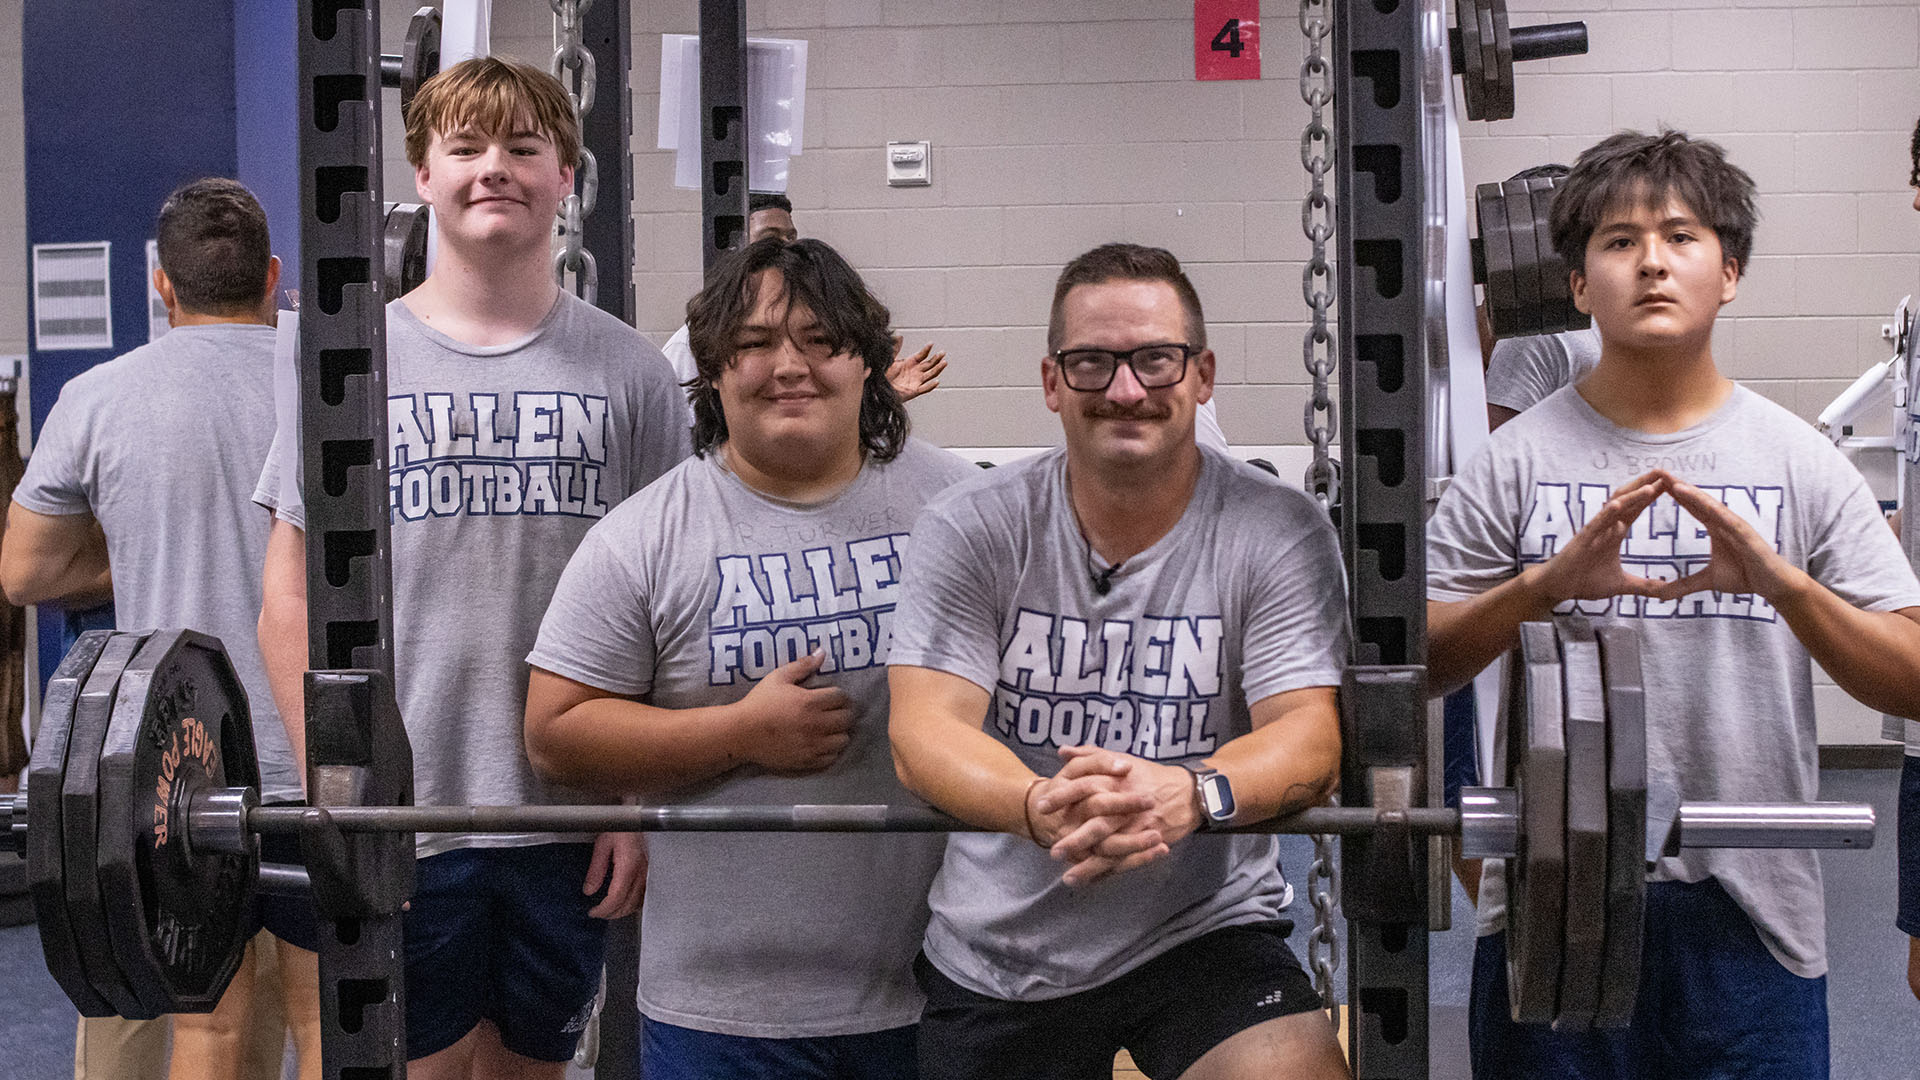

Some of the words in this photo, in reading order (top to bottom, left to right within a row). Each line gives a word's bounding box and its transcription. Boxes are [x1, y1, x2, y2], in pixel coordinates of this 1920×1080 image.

[1211, 18, 1245, 58] 4
[387, 391, 608, 470] ALLEN
[996, 607, 1224, 699] ALLEN
[181, 717, 218, 779] EAGLE
[994, 685, 1218, 761] FOOTBALL
[154, 731, 181, 849] POWER
